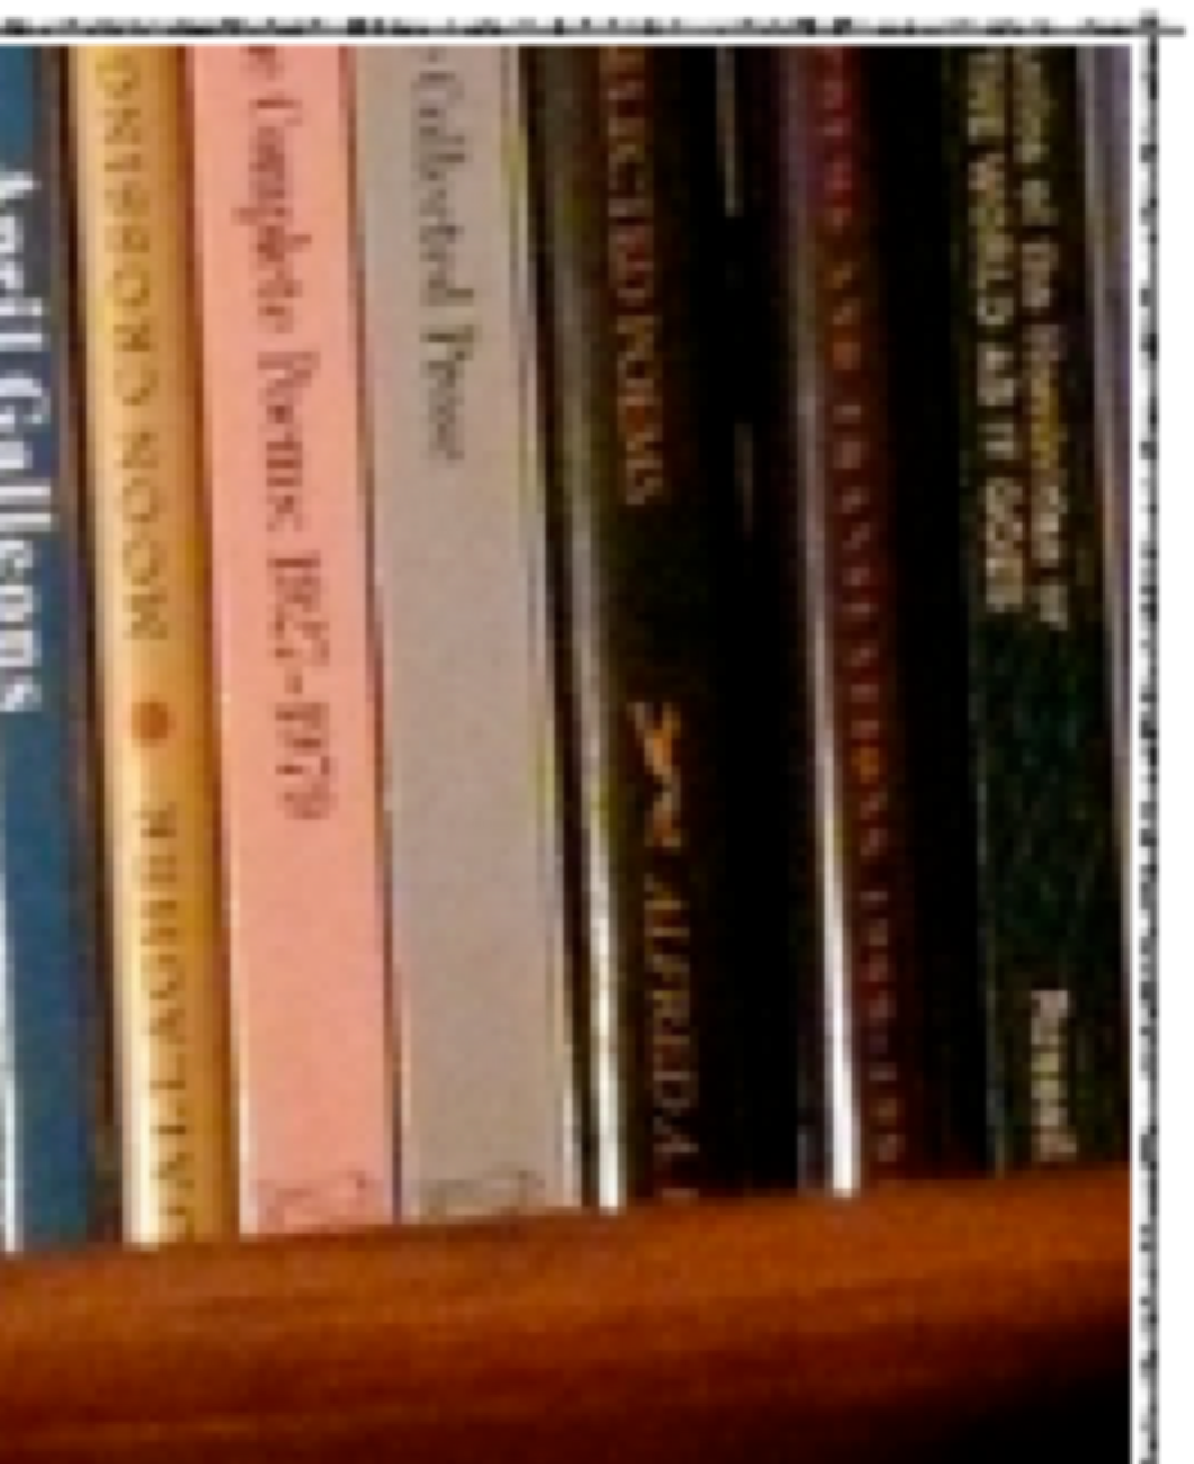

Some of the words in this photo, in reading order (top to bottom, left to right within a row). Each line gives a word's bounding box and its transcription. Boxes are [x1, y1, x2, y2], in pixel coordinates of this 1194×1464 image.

[96, 53, 155, 407] CROSSING
[414, 70, 471, 306] Collected
[966, 152, 1012, 326] WORLD
[236, 97, 308, 334] Complete
[272, 552, 333, 820] 1927-1979
[422, 322, 474, 463] Prose
[617, 312, 667, 506] POEMS
[974, 340, 1018, 407] AS
[122, 428, 172, 642] MOON
[982, 476, 1026, 614] GOES
